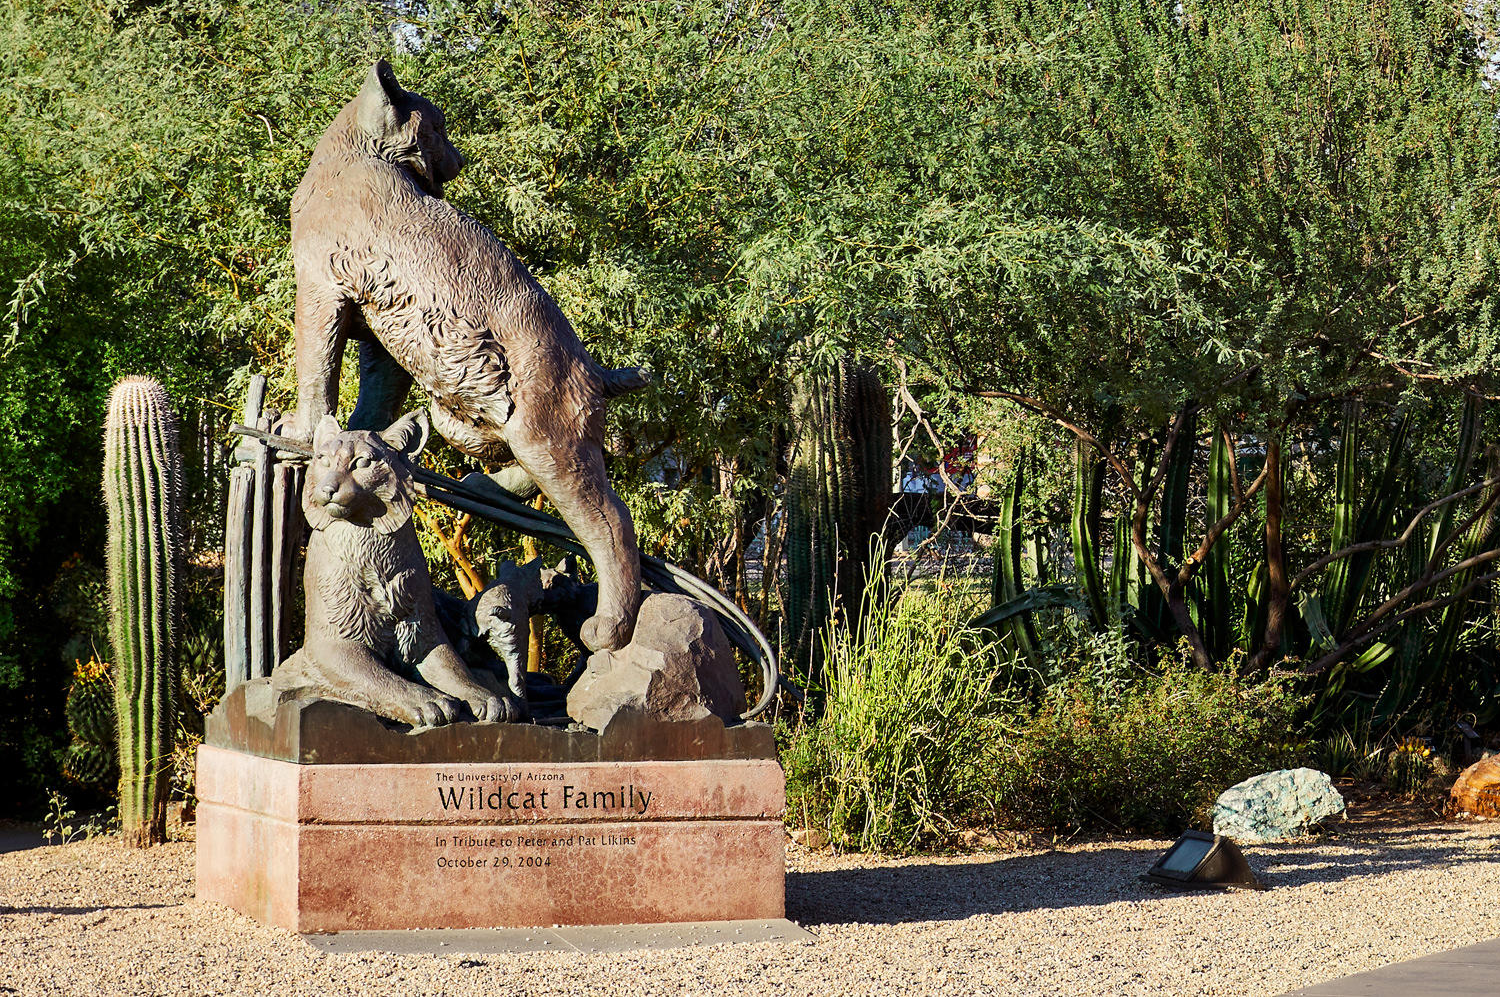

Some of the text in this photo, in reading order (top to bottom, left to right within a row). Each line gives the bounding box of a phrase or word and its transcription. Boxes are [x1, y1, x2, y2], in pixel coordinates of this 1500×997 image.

[436, 772, 565, 783] The University of Arizona
[438, 784, 652, 814] Wildcat Family
[435, 834, 636, 847] In Tribute to Peter and Pat Likins
[437, 856, 552, 869] October 29, 2004
